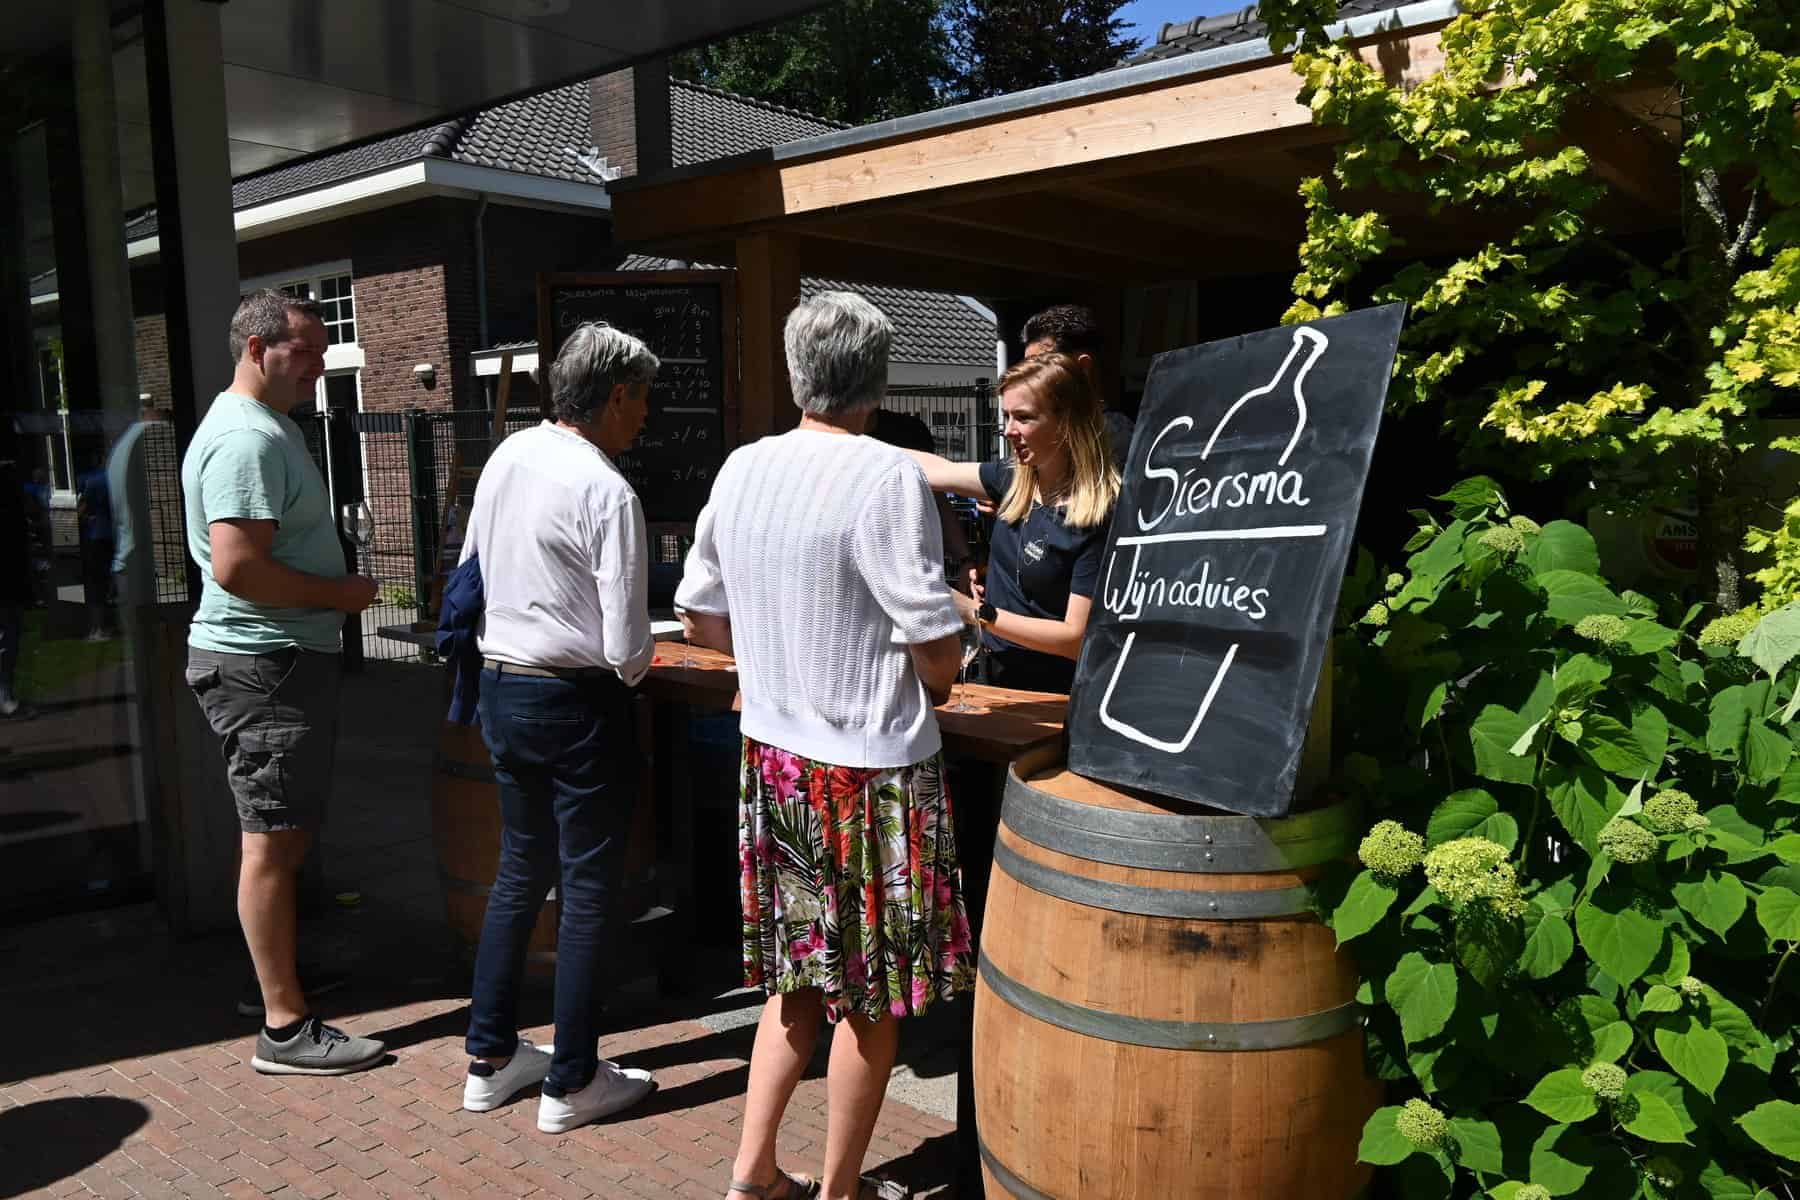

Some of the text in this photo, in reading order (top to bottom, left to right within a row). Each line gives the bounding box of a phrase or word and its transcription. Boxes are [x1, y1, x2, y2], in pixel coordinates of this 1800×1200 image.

[1137, 416, 1310, 532] Siersma
[1663, 525, 1697, 537] AMS
[1103, 543, 1270, 622] Wijnadvies
